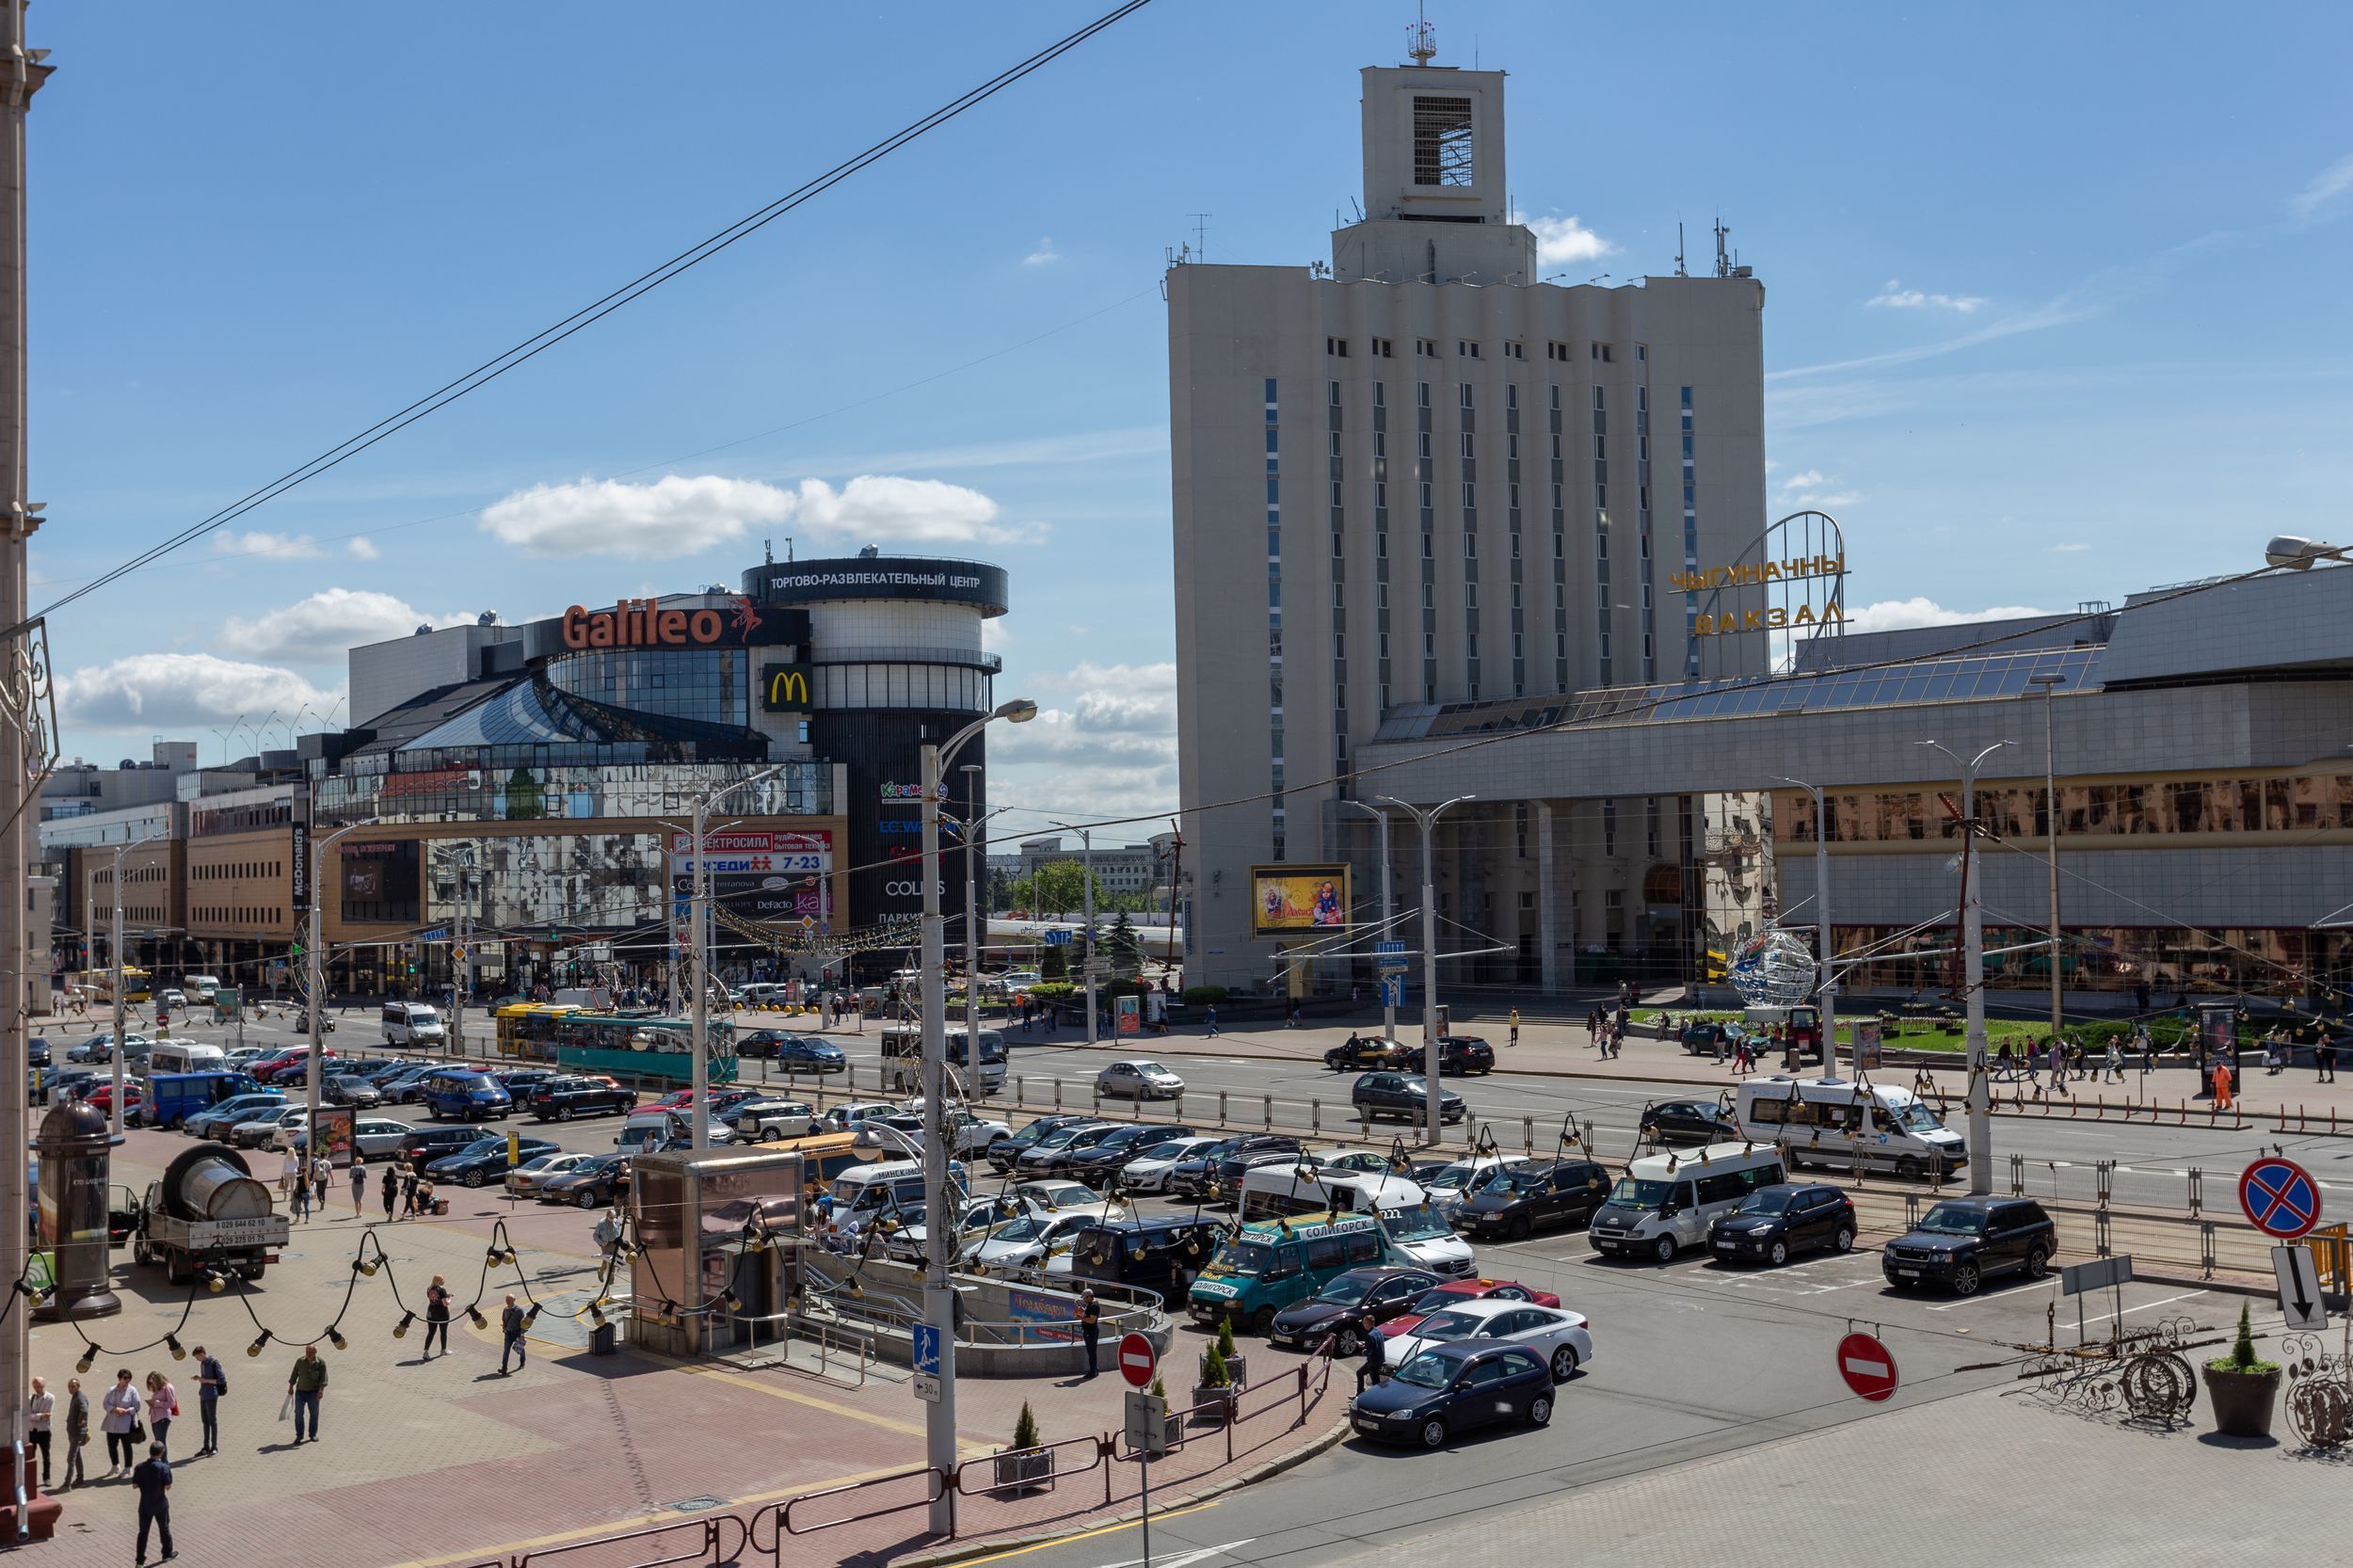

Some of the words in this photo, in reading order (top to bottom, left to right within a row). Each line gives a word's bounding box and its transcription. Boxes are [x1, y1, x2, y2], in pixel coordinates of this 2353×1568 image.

[1670, 552, 1845, 589] ЧЫГУНАЧНЫ
[771, 572, 946, 589] ТОРГОВО-РАЗВЛЕКАТЕЛЬНЫЙ
[950, 575, 981, 588] ЦЕНТР
[563, 599, 722, 648] Galileo
[1694, 601, 1845, 634] ВАКЗАЛ
[783, 856, 820, 869] 7-23
[1305, 1219, 1368, 1239] СОЛИГОРСК
[1193, 1282, 1236, 1296] СОЛИГОРСК
[924, 1383, 934, 1394] 30
